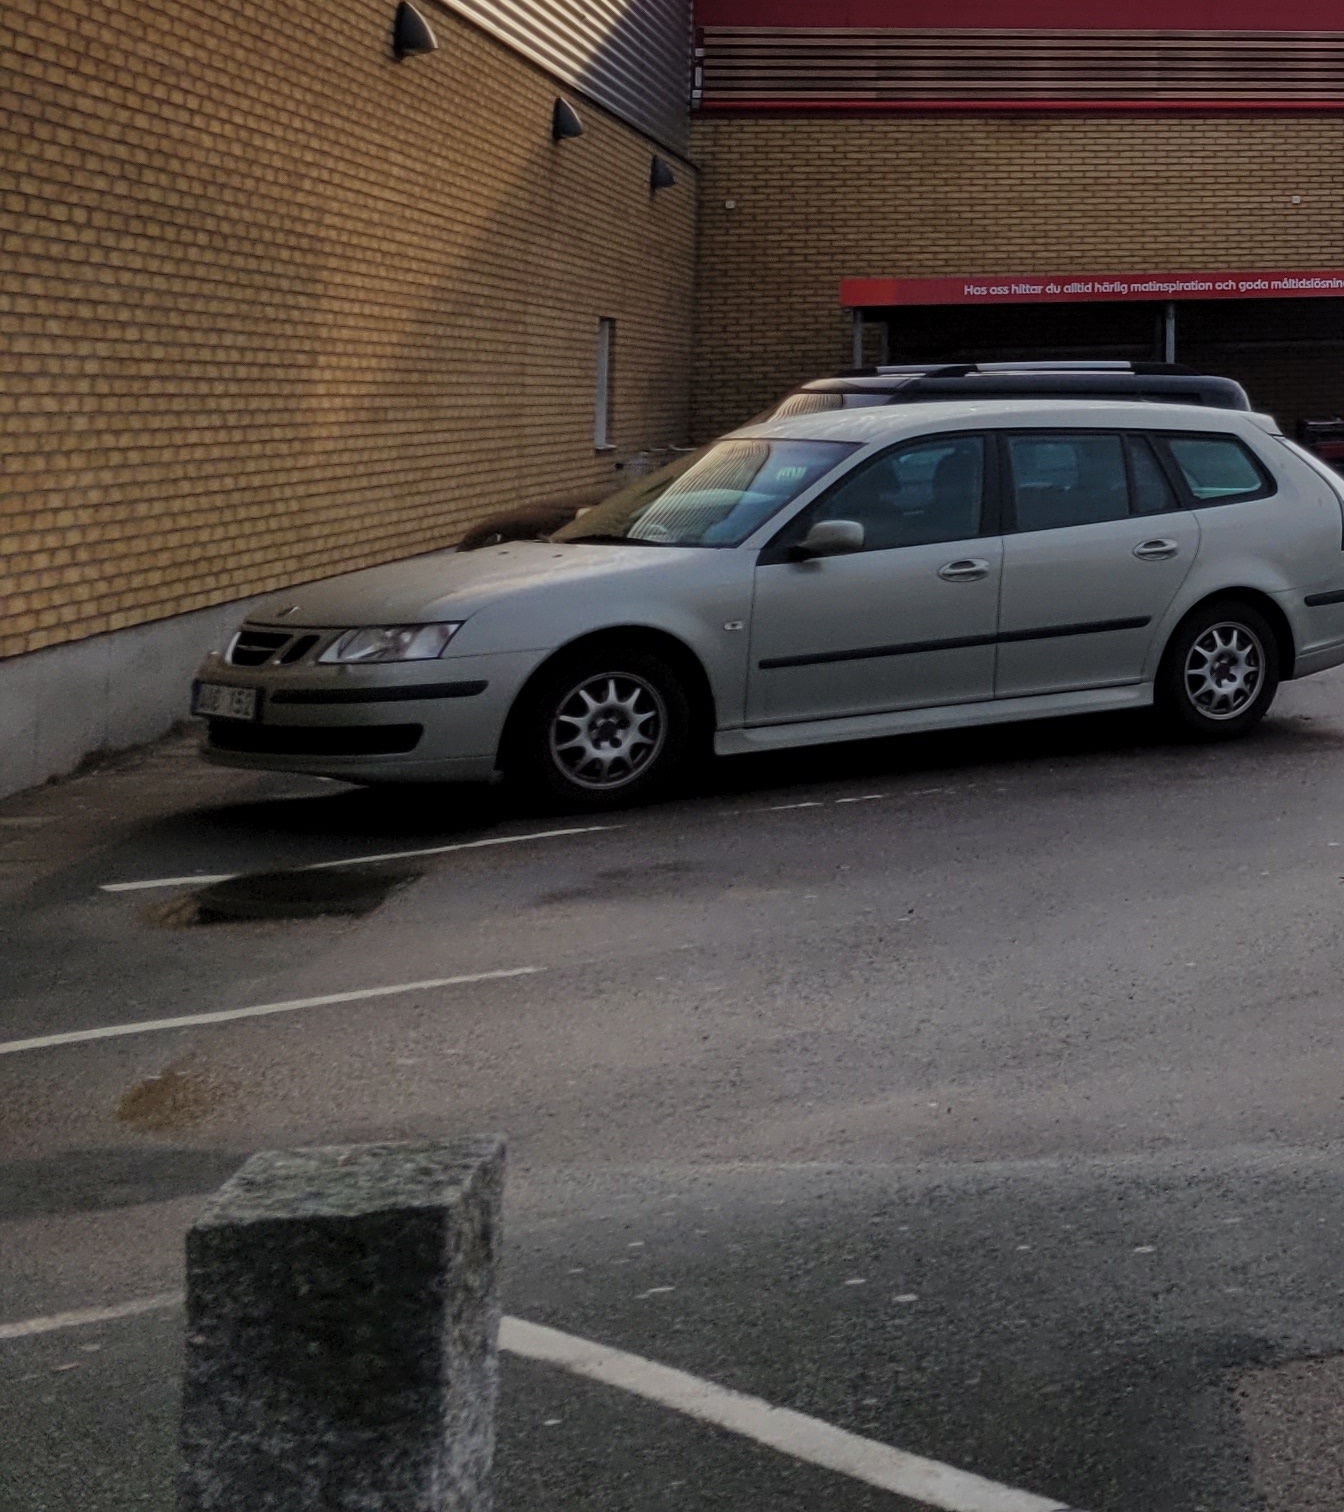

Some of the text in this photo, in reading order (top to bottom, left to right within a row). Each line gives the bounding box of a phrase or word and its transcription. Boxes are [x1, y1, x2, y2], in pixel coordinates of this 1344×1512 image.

[964, 285, 987, 295] Hos
[990, 285, 1009, 295] oss
[1011, 283, 1044, 294] hittar
[1045, 283, 1061, 293] du
[1063, 282, 1092, 293] alltid
[1094, 281, 1128, 294] härlig
[1130, 280, 1213, 294] matinspiration
[1215, 280, 1236, 291] och
[1238, 278, 1269, 292] goda
